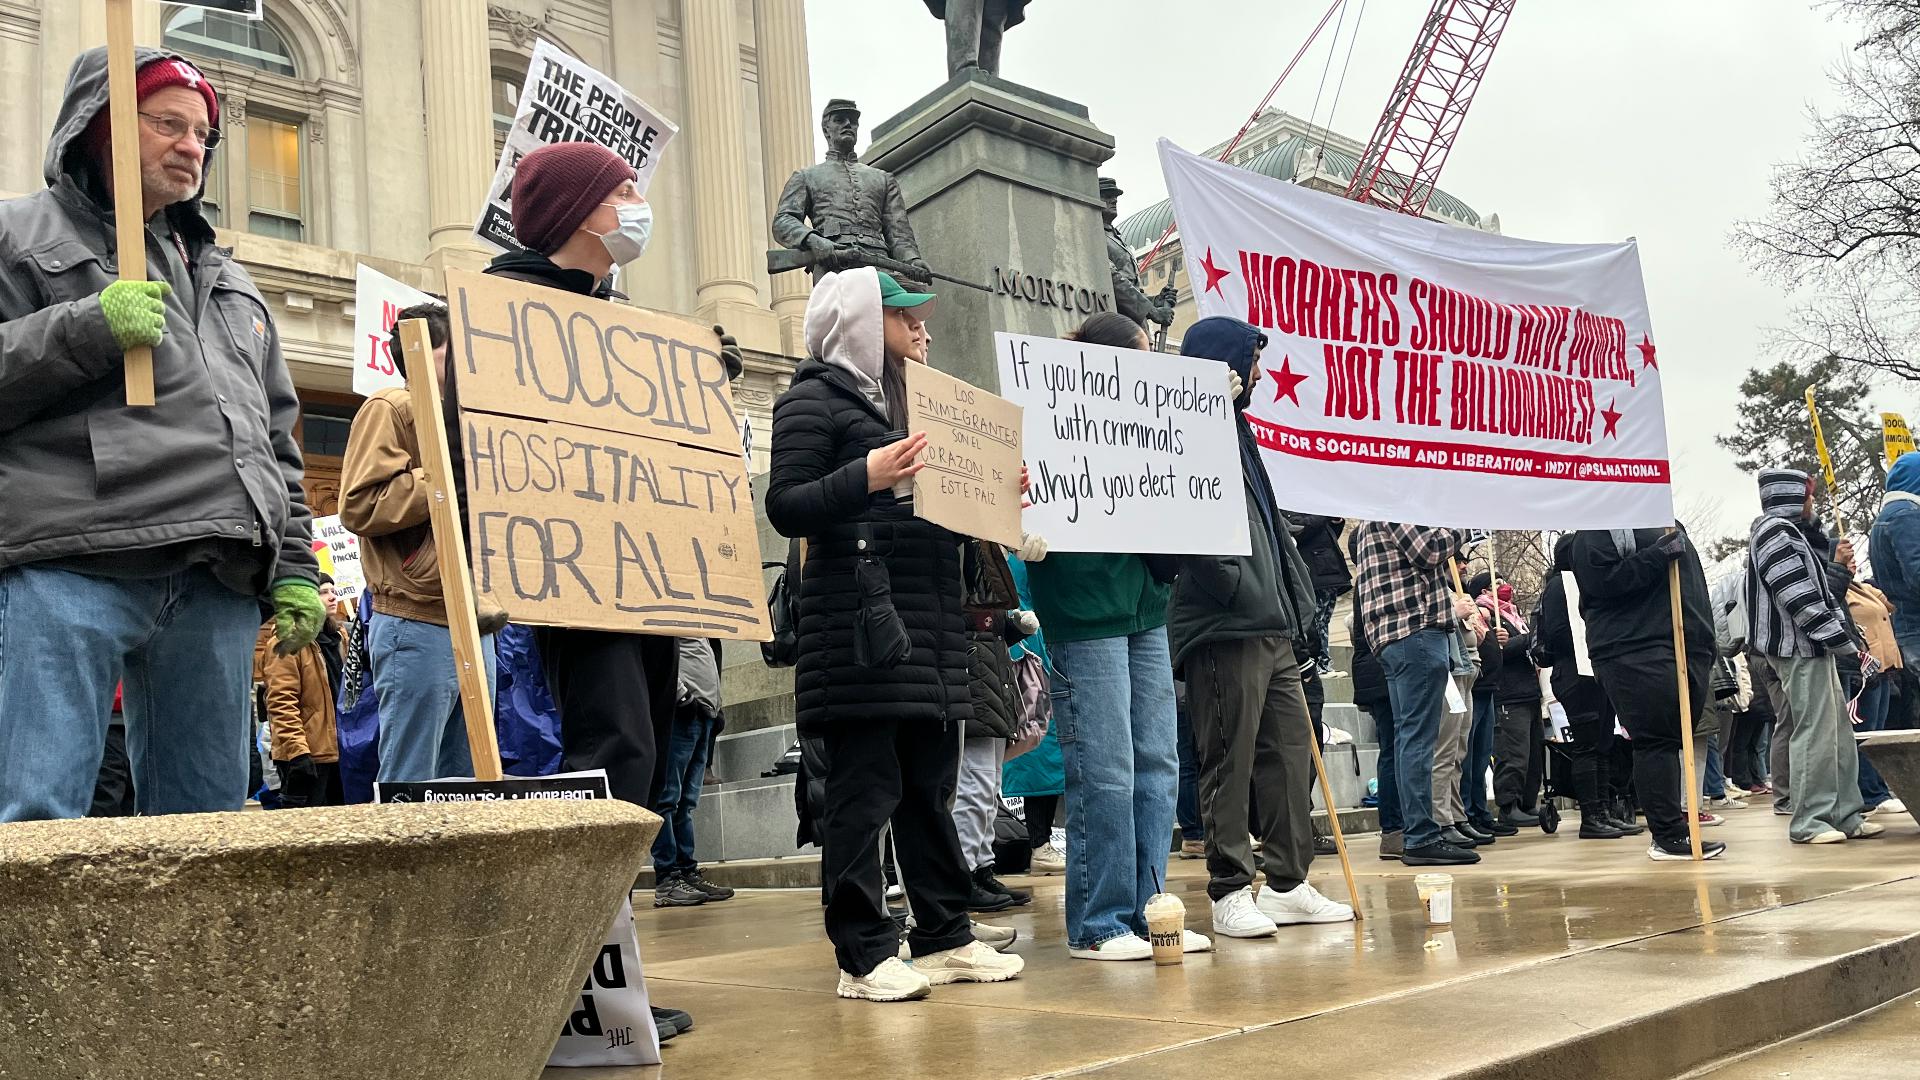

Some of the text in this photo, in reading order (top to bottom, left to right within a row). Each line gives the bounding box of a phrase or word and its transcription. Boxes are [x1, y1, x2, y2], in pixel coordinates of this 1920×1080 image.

[526, 101, 597, 145] TRU
[537, 80, 648, 171] WILL DEFEAT
[543, 57, 658, 151] THE PEOPLE
[493, 212, 514, 231] Party
[994, 265, 1110, 315] MORTON
[1238, 250, 1636, 388] WORKERS SHOULD HAVE POWER,
[458, 286, 741, 435] HOOSIER
[1010, 340, 1227, 420] If you had a problem
[954, 384, 975, 405] LOS
[1324, 343, 1596, 445] NOT THE BILLIONAIRES!
[915, 391, 1018, 447] INMIGRANTES
[951, 428, 981, 450] SON EL
[1054, 403, 1184, 455] with criminals
[468, 421, 741, 514] HOSPITALITY
[920, 445, 984, 477] CORAZON
[992, 468, 1003, 483] DE
[1280, 433, 1311, 451] FOR
[1315, 437, 1411, 460] SOCIALISM
[1415, 449, 1448, 465] AND
[1452, 451, 1534, 472] LIBERATION
[1545, 462, 1572, 475] INDY
[1578, 462, 1661, 478] @PSLNATIONAL
[941, 476, 997, 506] ESTE PAIZ
[1022, 455, 1222, 524] Why'd you elect one
[321, 525, 345, 538] VALE
[331, 541, 345, 552] UN
[478, 511, 602, 605] FOR
[614, 520, 754, 608] ALL
[1006, 797, 1022, 807] PARA
[605, 1026, 635, 1050] THE
